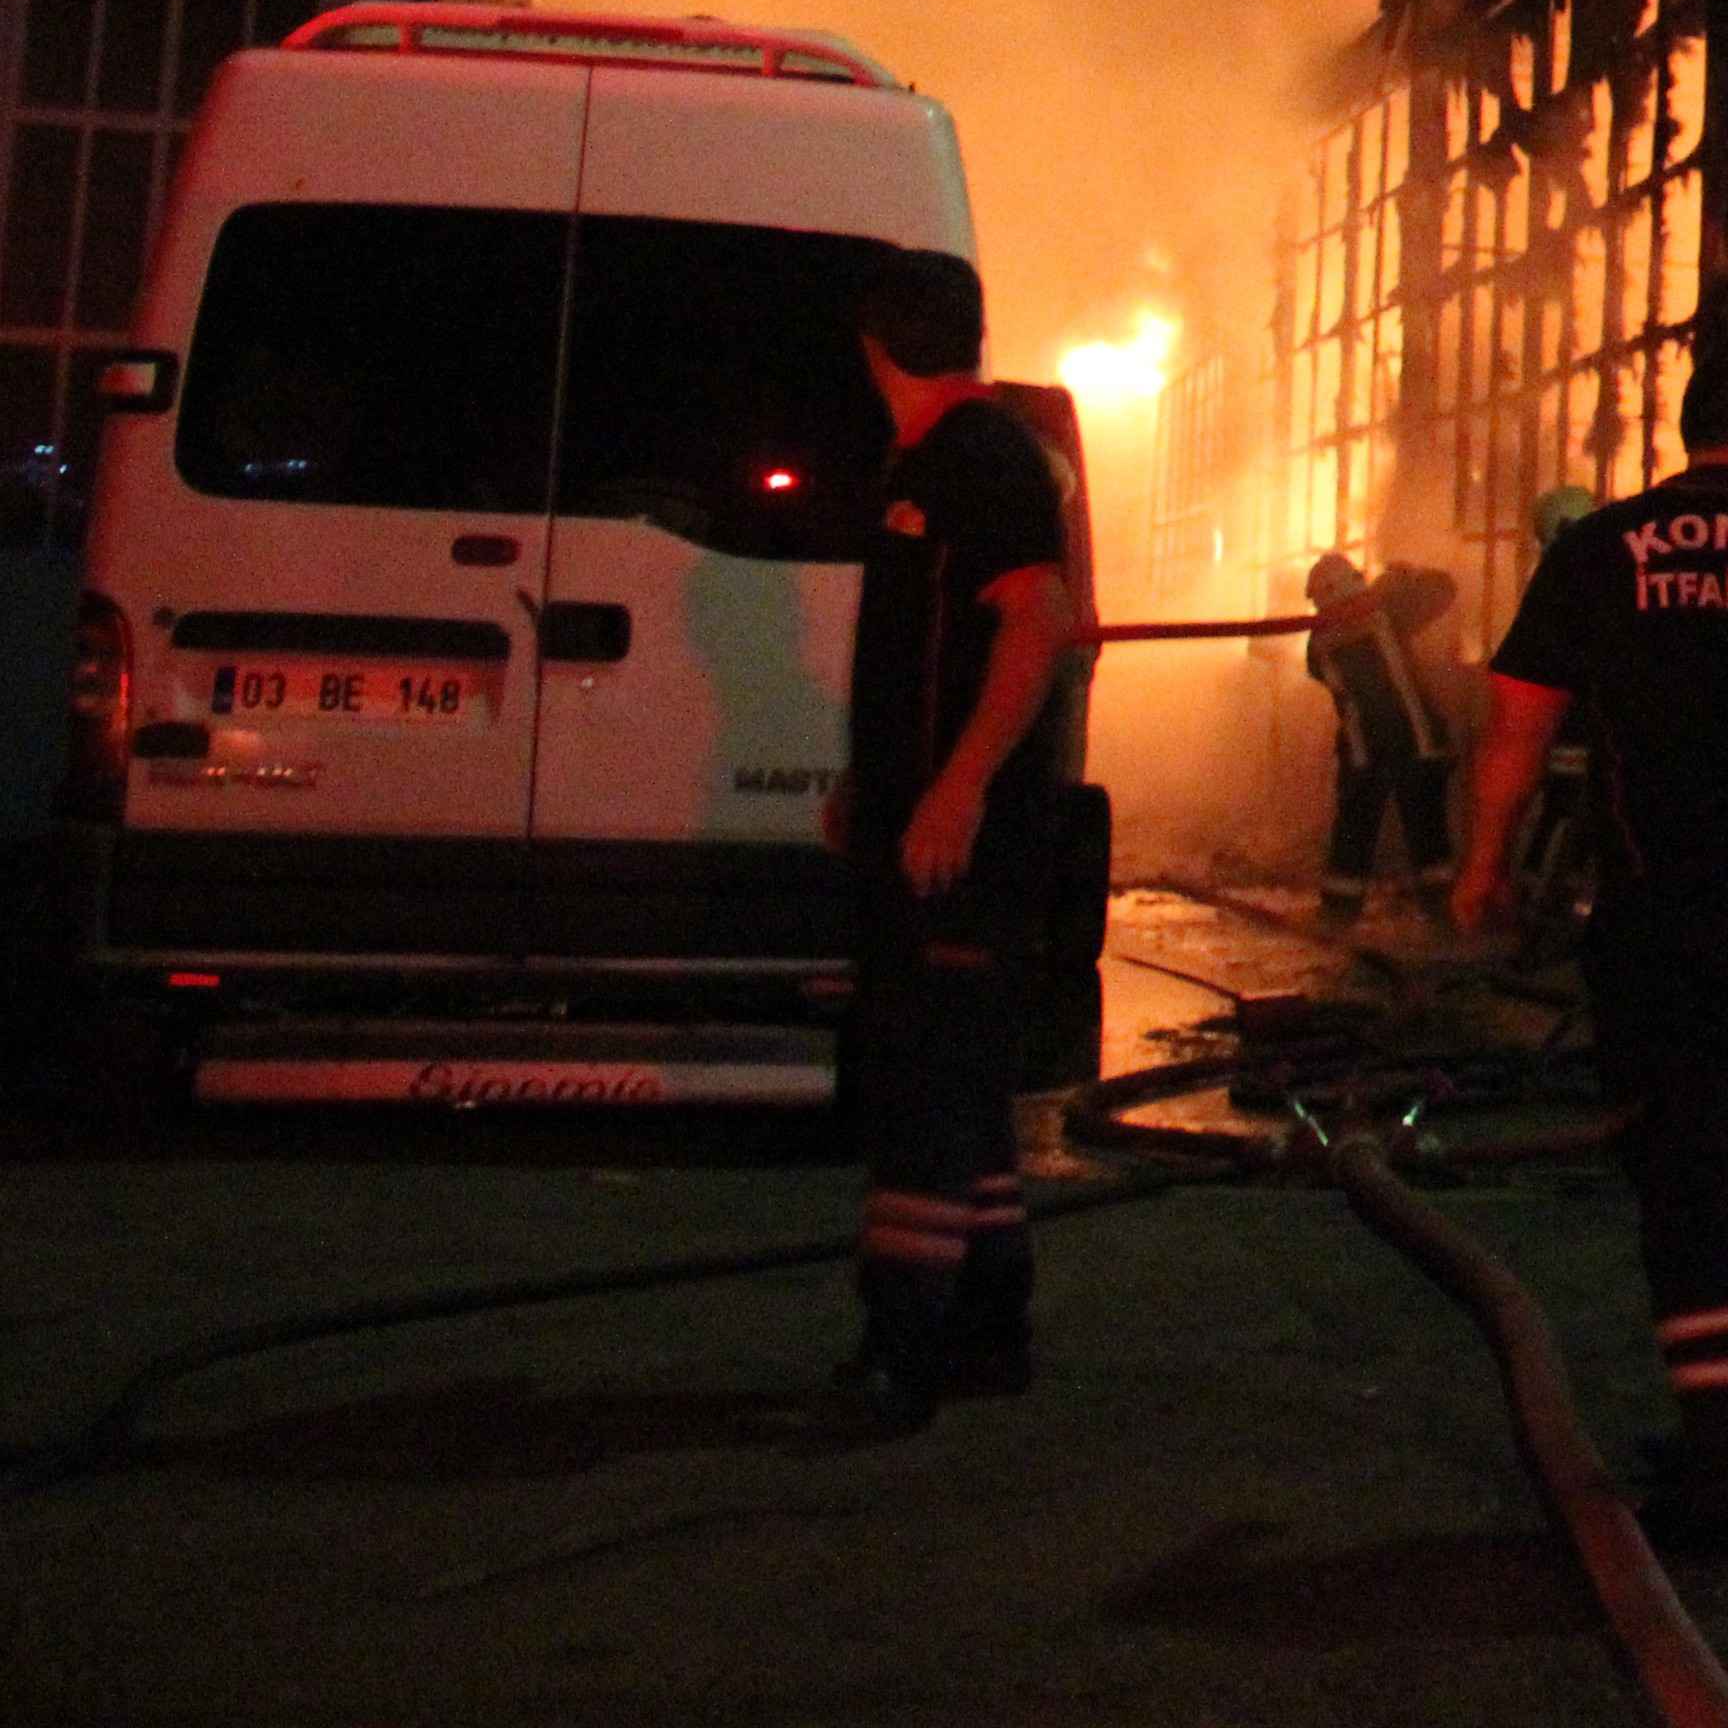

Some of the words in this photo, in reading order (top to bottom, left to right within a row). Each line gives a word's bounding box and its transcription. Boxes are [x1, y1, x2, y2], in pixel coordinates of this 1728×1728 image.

[242, 672, 287, 709] 03
[318, 673, 366, 712] BE
[399, 675, 462, 715] 148
[735, 767, 852, 795] MAST
